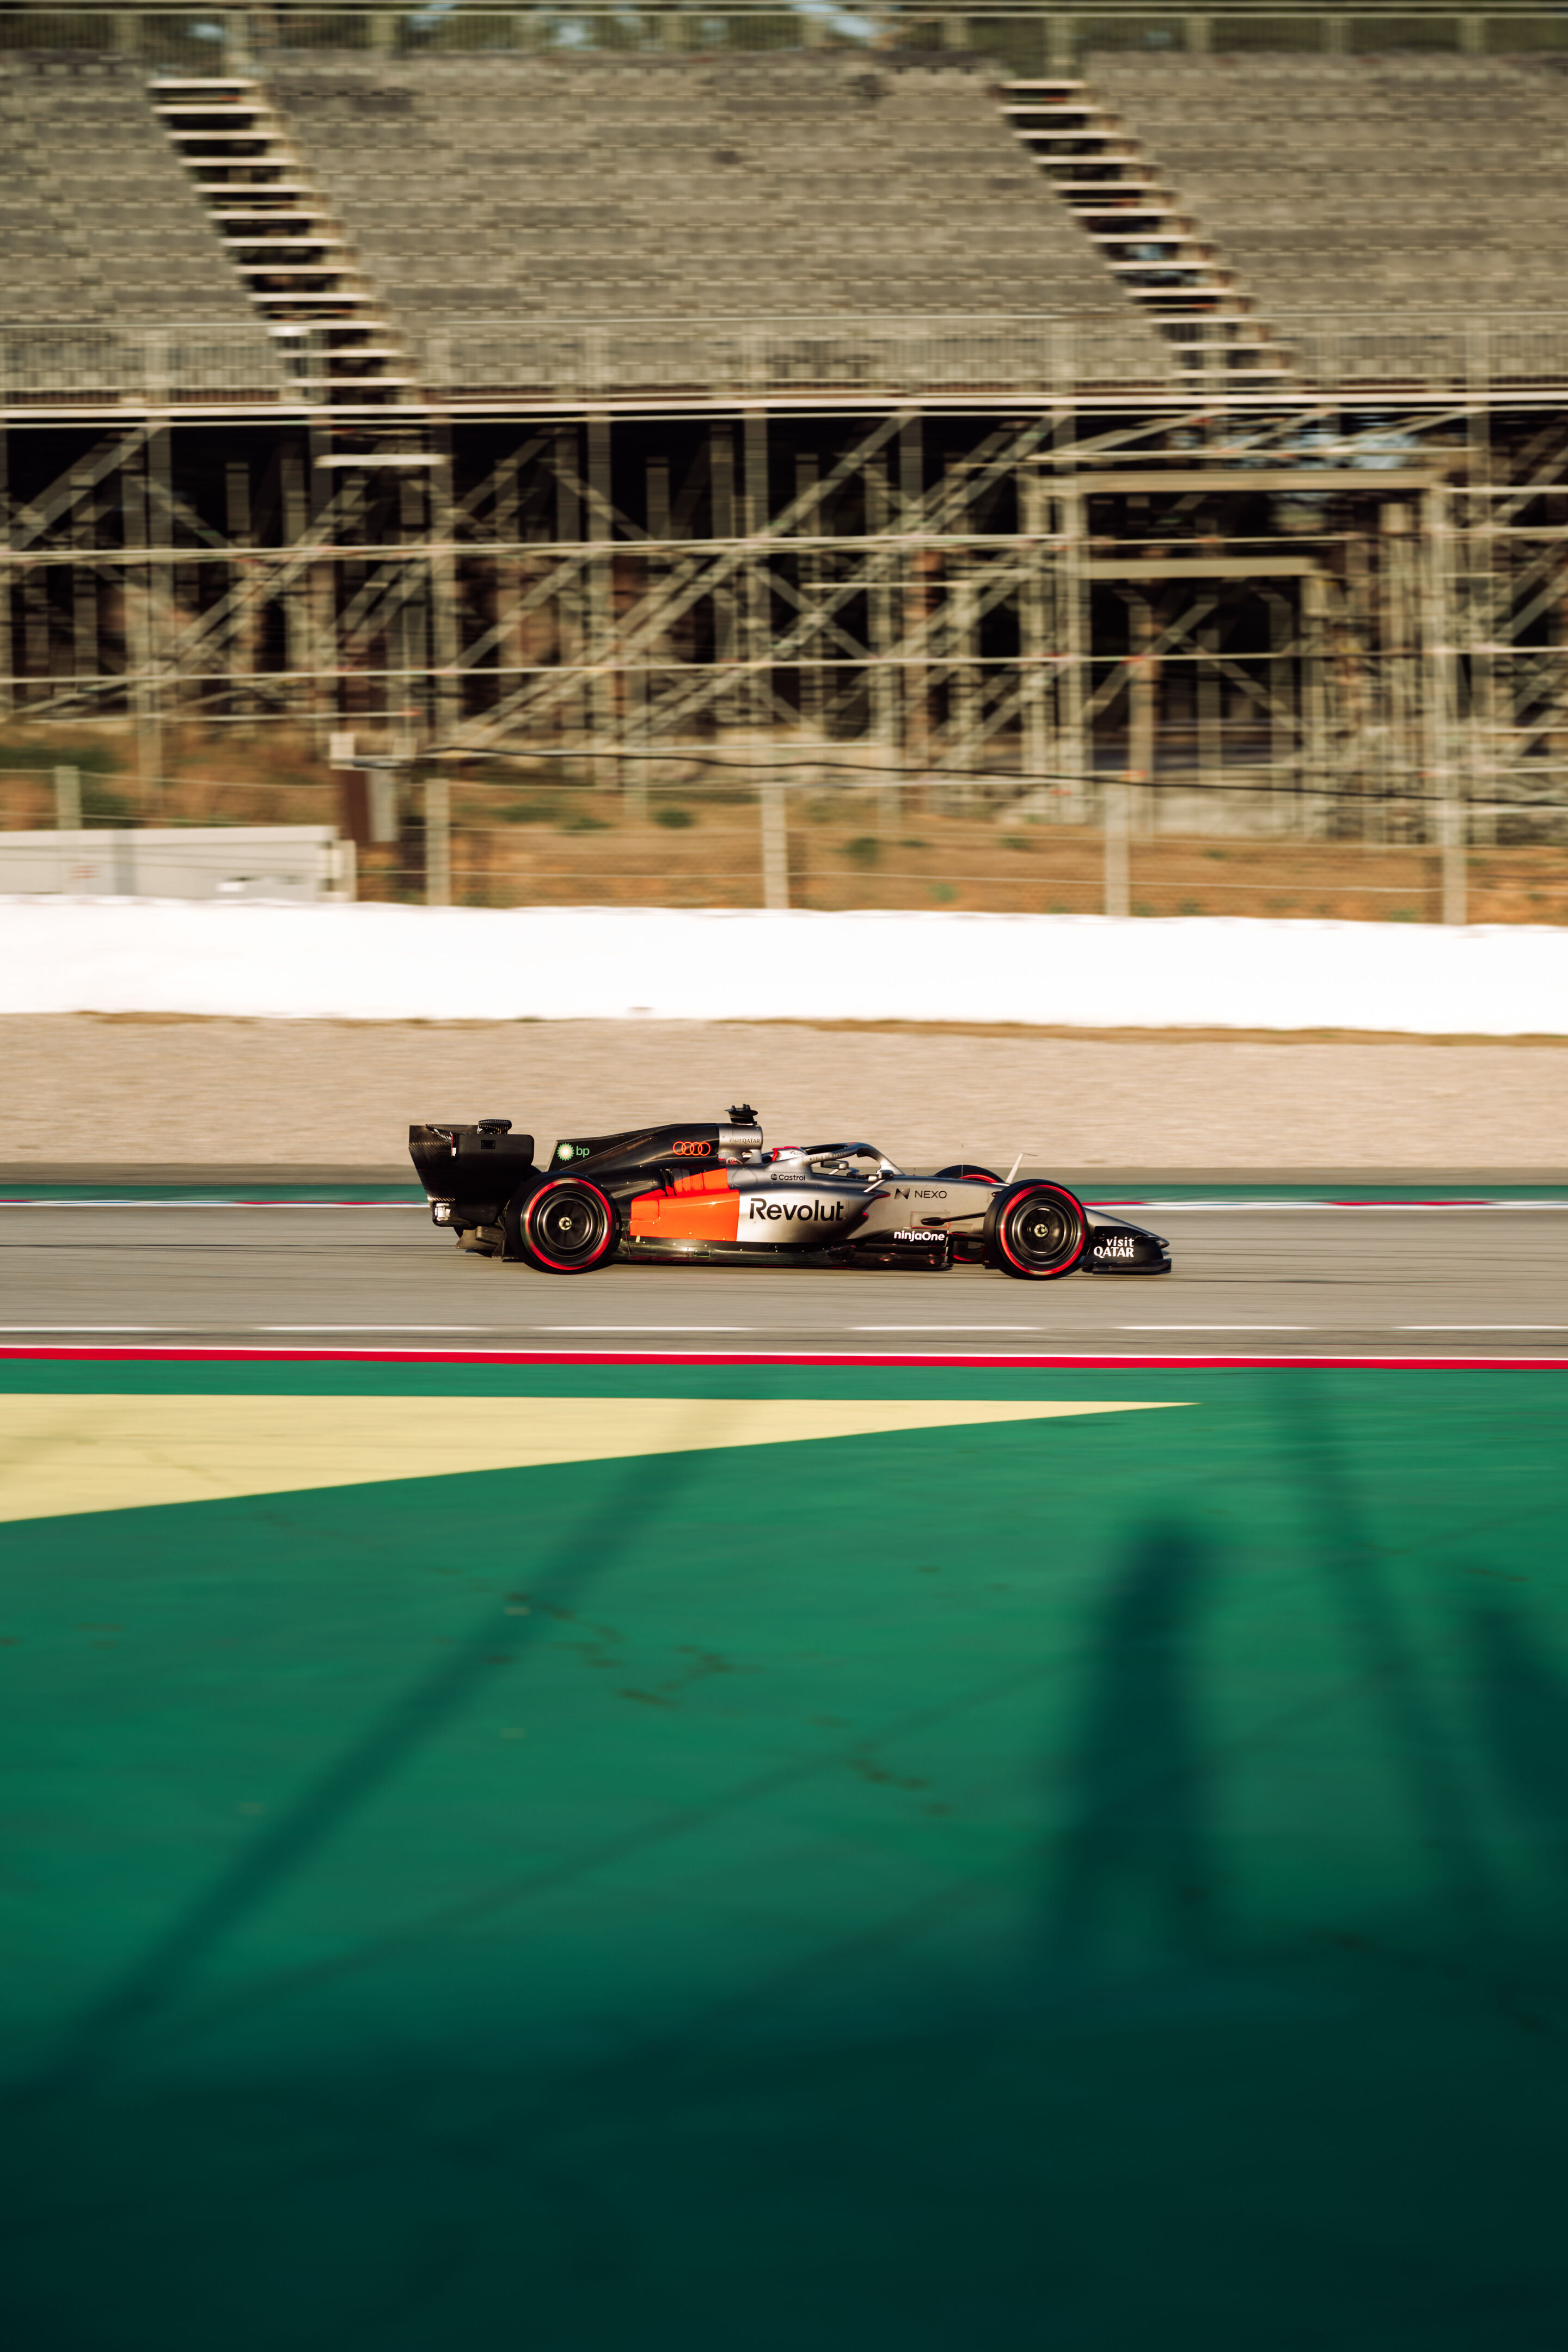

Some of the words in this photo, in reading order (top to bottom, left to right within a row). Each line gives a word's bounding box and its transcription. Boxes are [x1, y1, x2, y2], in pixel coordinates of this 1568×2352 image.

[576, 1146, 590, 1158] bp
[915, 1190, 947, 1198] NEXO
[749, 1198, 844, 1222] Revolut
[893, 1230, 945, 1242] ninjaOne
[1106, 1236, 1135, 1247] visit
[1093, 1246, 1134, 1259] QATAR
